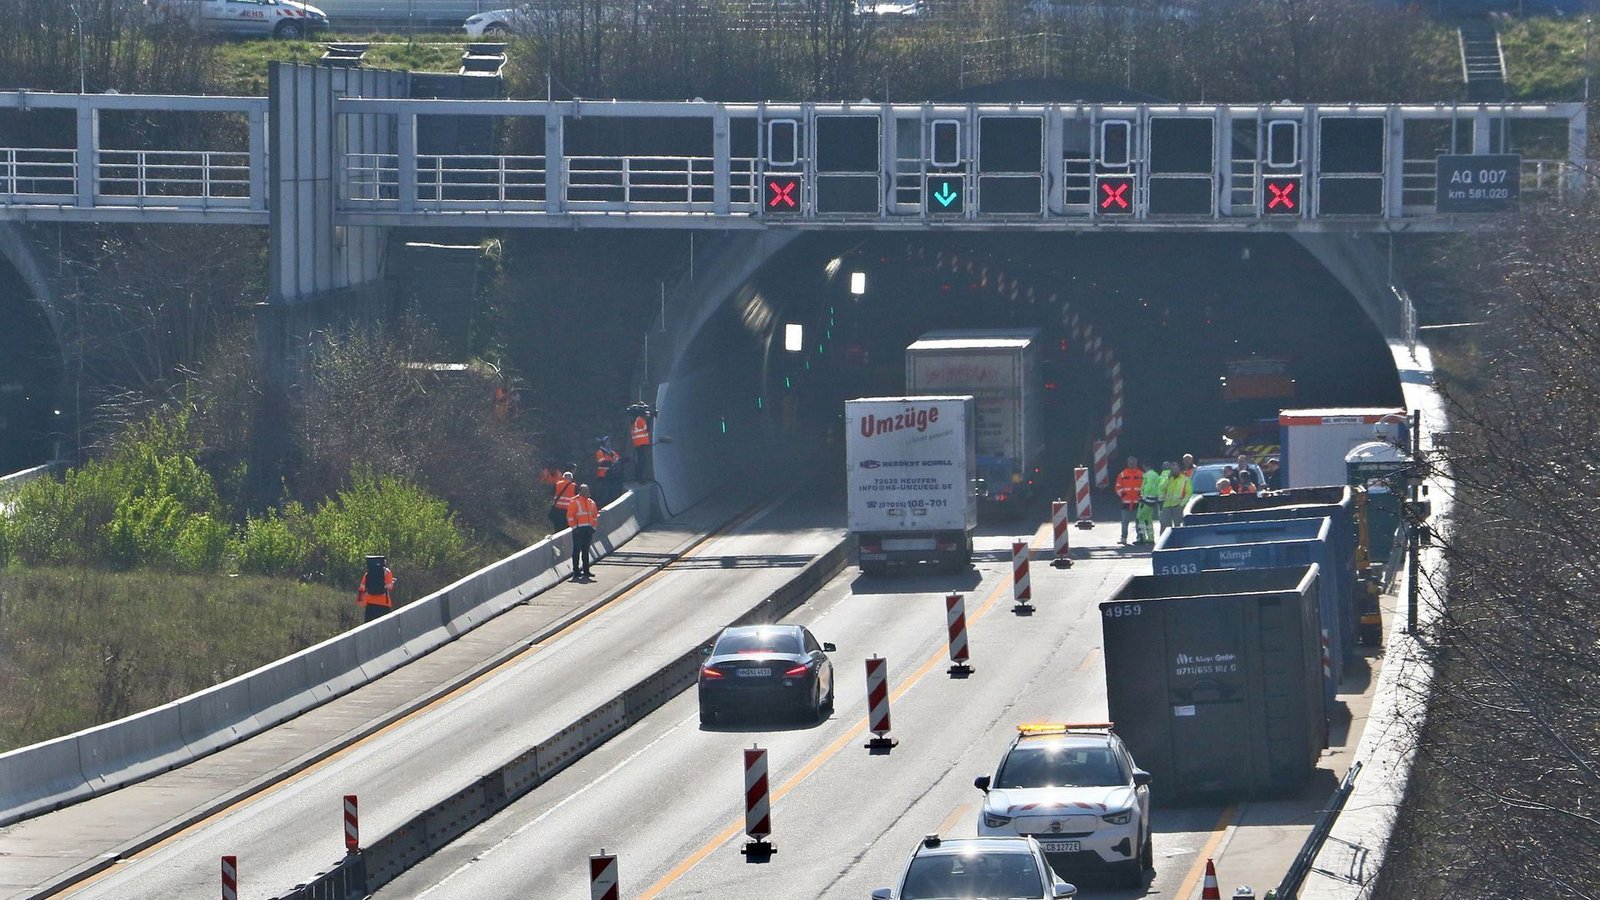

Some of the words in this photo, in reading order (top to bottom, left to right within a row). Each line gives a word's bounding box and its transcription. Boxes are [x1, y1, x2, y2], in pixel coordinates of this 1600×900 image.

[1451, 170, 1472, 183] AQ
[1479, 169, 1507, 183] 007
[1449, 189, 1465, 199] km
[861, 407, 939, 438] Umzüge
[1219, 549, 1252, 561] Kämpf
[1162, 563, 1198, 575] 5033
[1105, 604, 1142, 618] 4959
